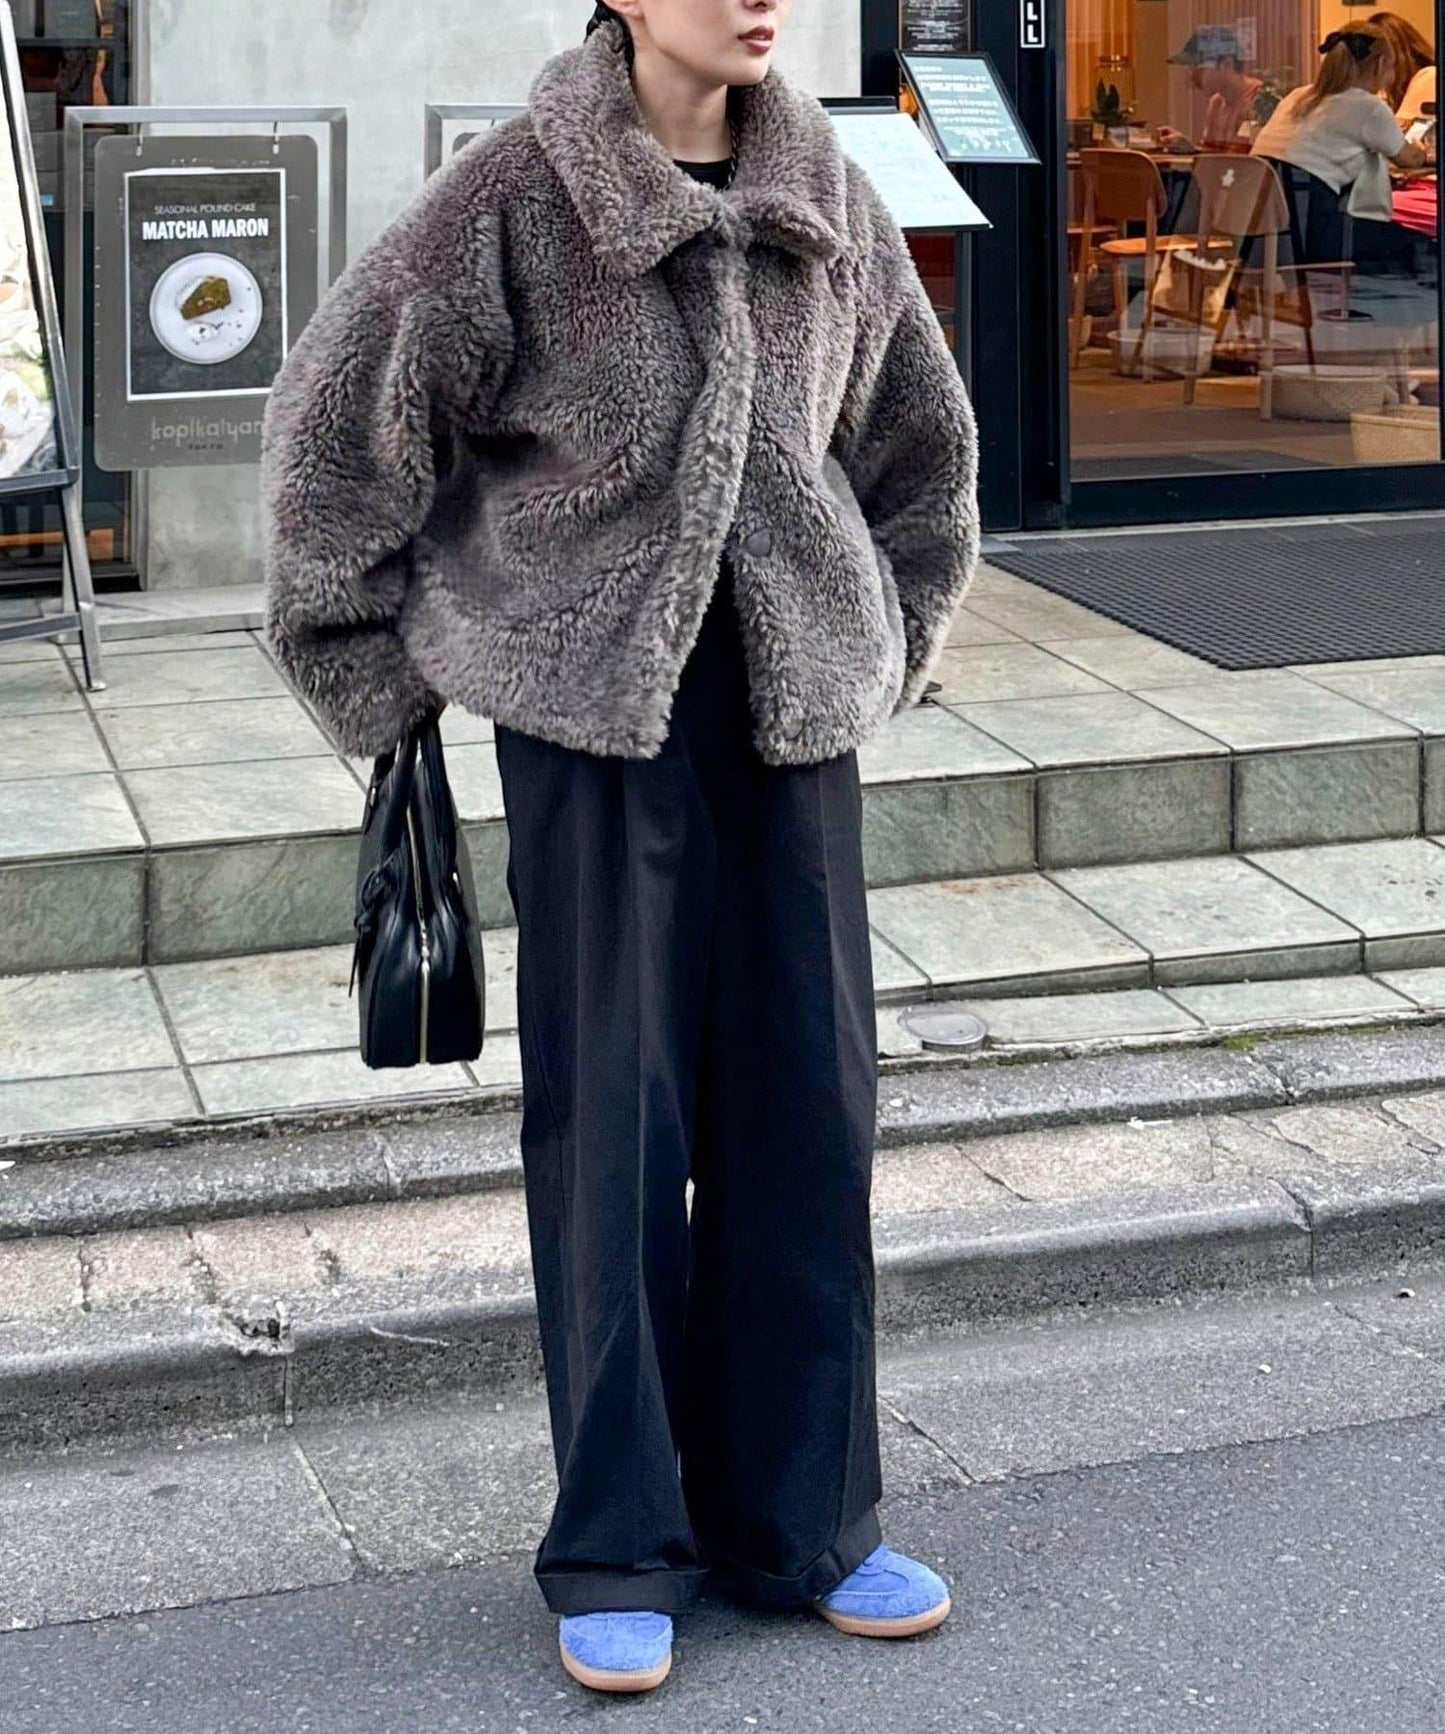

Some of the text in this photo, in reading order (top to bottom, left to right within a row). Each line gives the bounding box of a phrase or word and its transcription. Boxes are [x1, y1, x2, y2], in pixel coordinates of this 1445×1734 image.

[153, 202, 257, 215] SEASONAL POUND CAKE
[142, 218, 269, 240] MATCHA MARON
